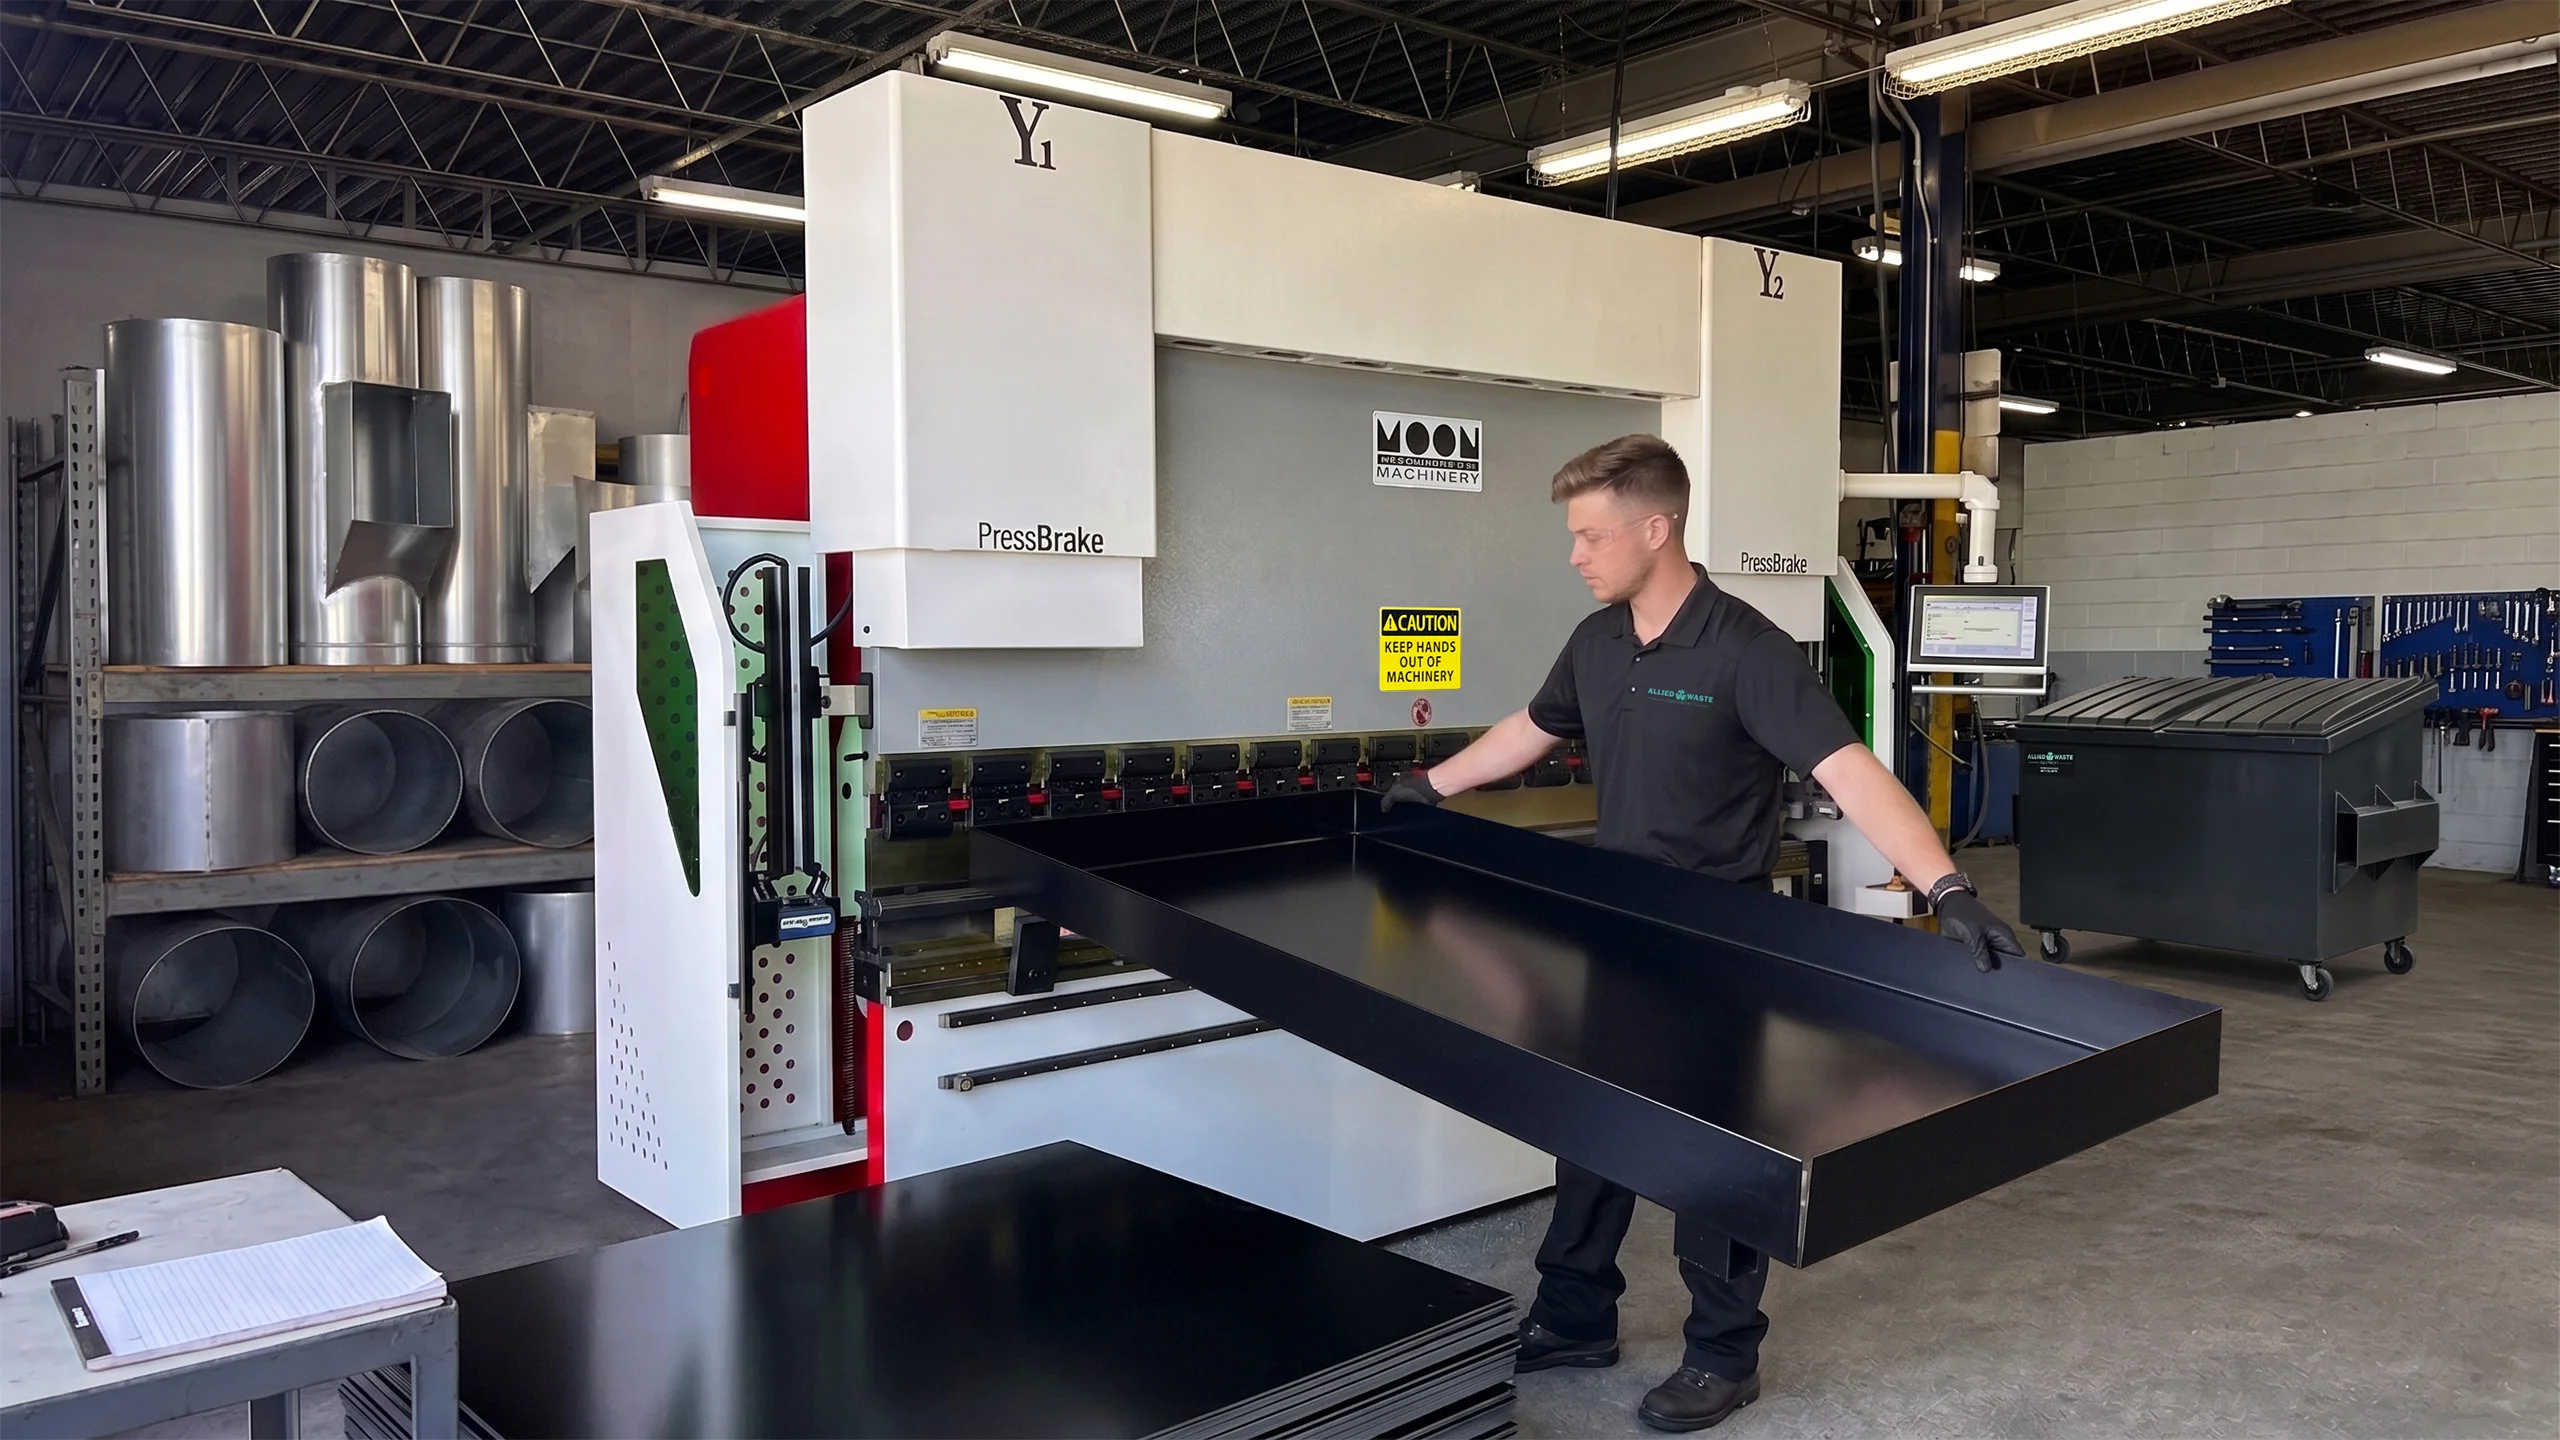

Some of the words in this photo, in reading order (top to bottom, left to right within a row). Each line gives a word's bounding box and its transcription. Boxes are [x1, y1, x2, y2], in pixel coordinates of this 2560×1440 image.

[1377, 418, 1479, 460] MOON
[1376, 466, 1479, 484] MACHINERY
[979, 522, 1104, 553] PressBrake
[1741, 552, 1807, 573] PressBrake
[1398, 614, 1457, 632] CAUTION
[1385, 641, 1413, 653] KEEP
[1416, 641, 1456, 653] HANDS
[1399, 656, 1424, 668] OUT
[1427, 656, 1442, 667] OF
[1387, 671, 1454, 683] MACHINERY
[1648, 687, 1675, 698] ALLIED
[1687, 693, 1714, 703] WASTE
